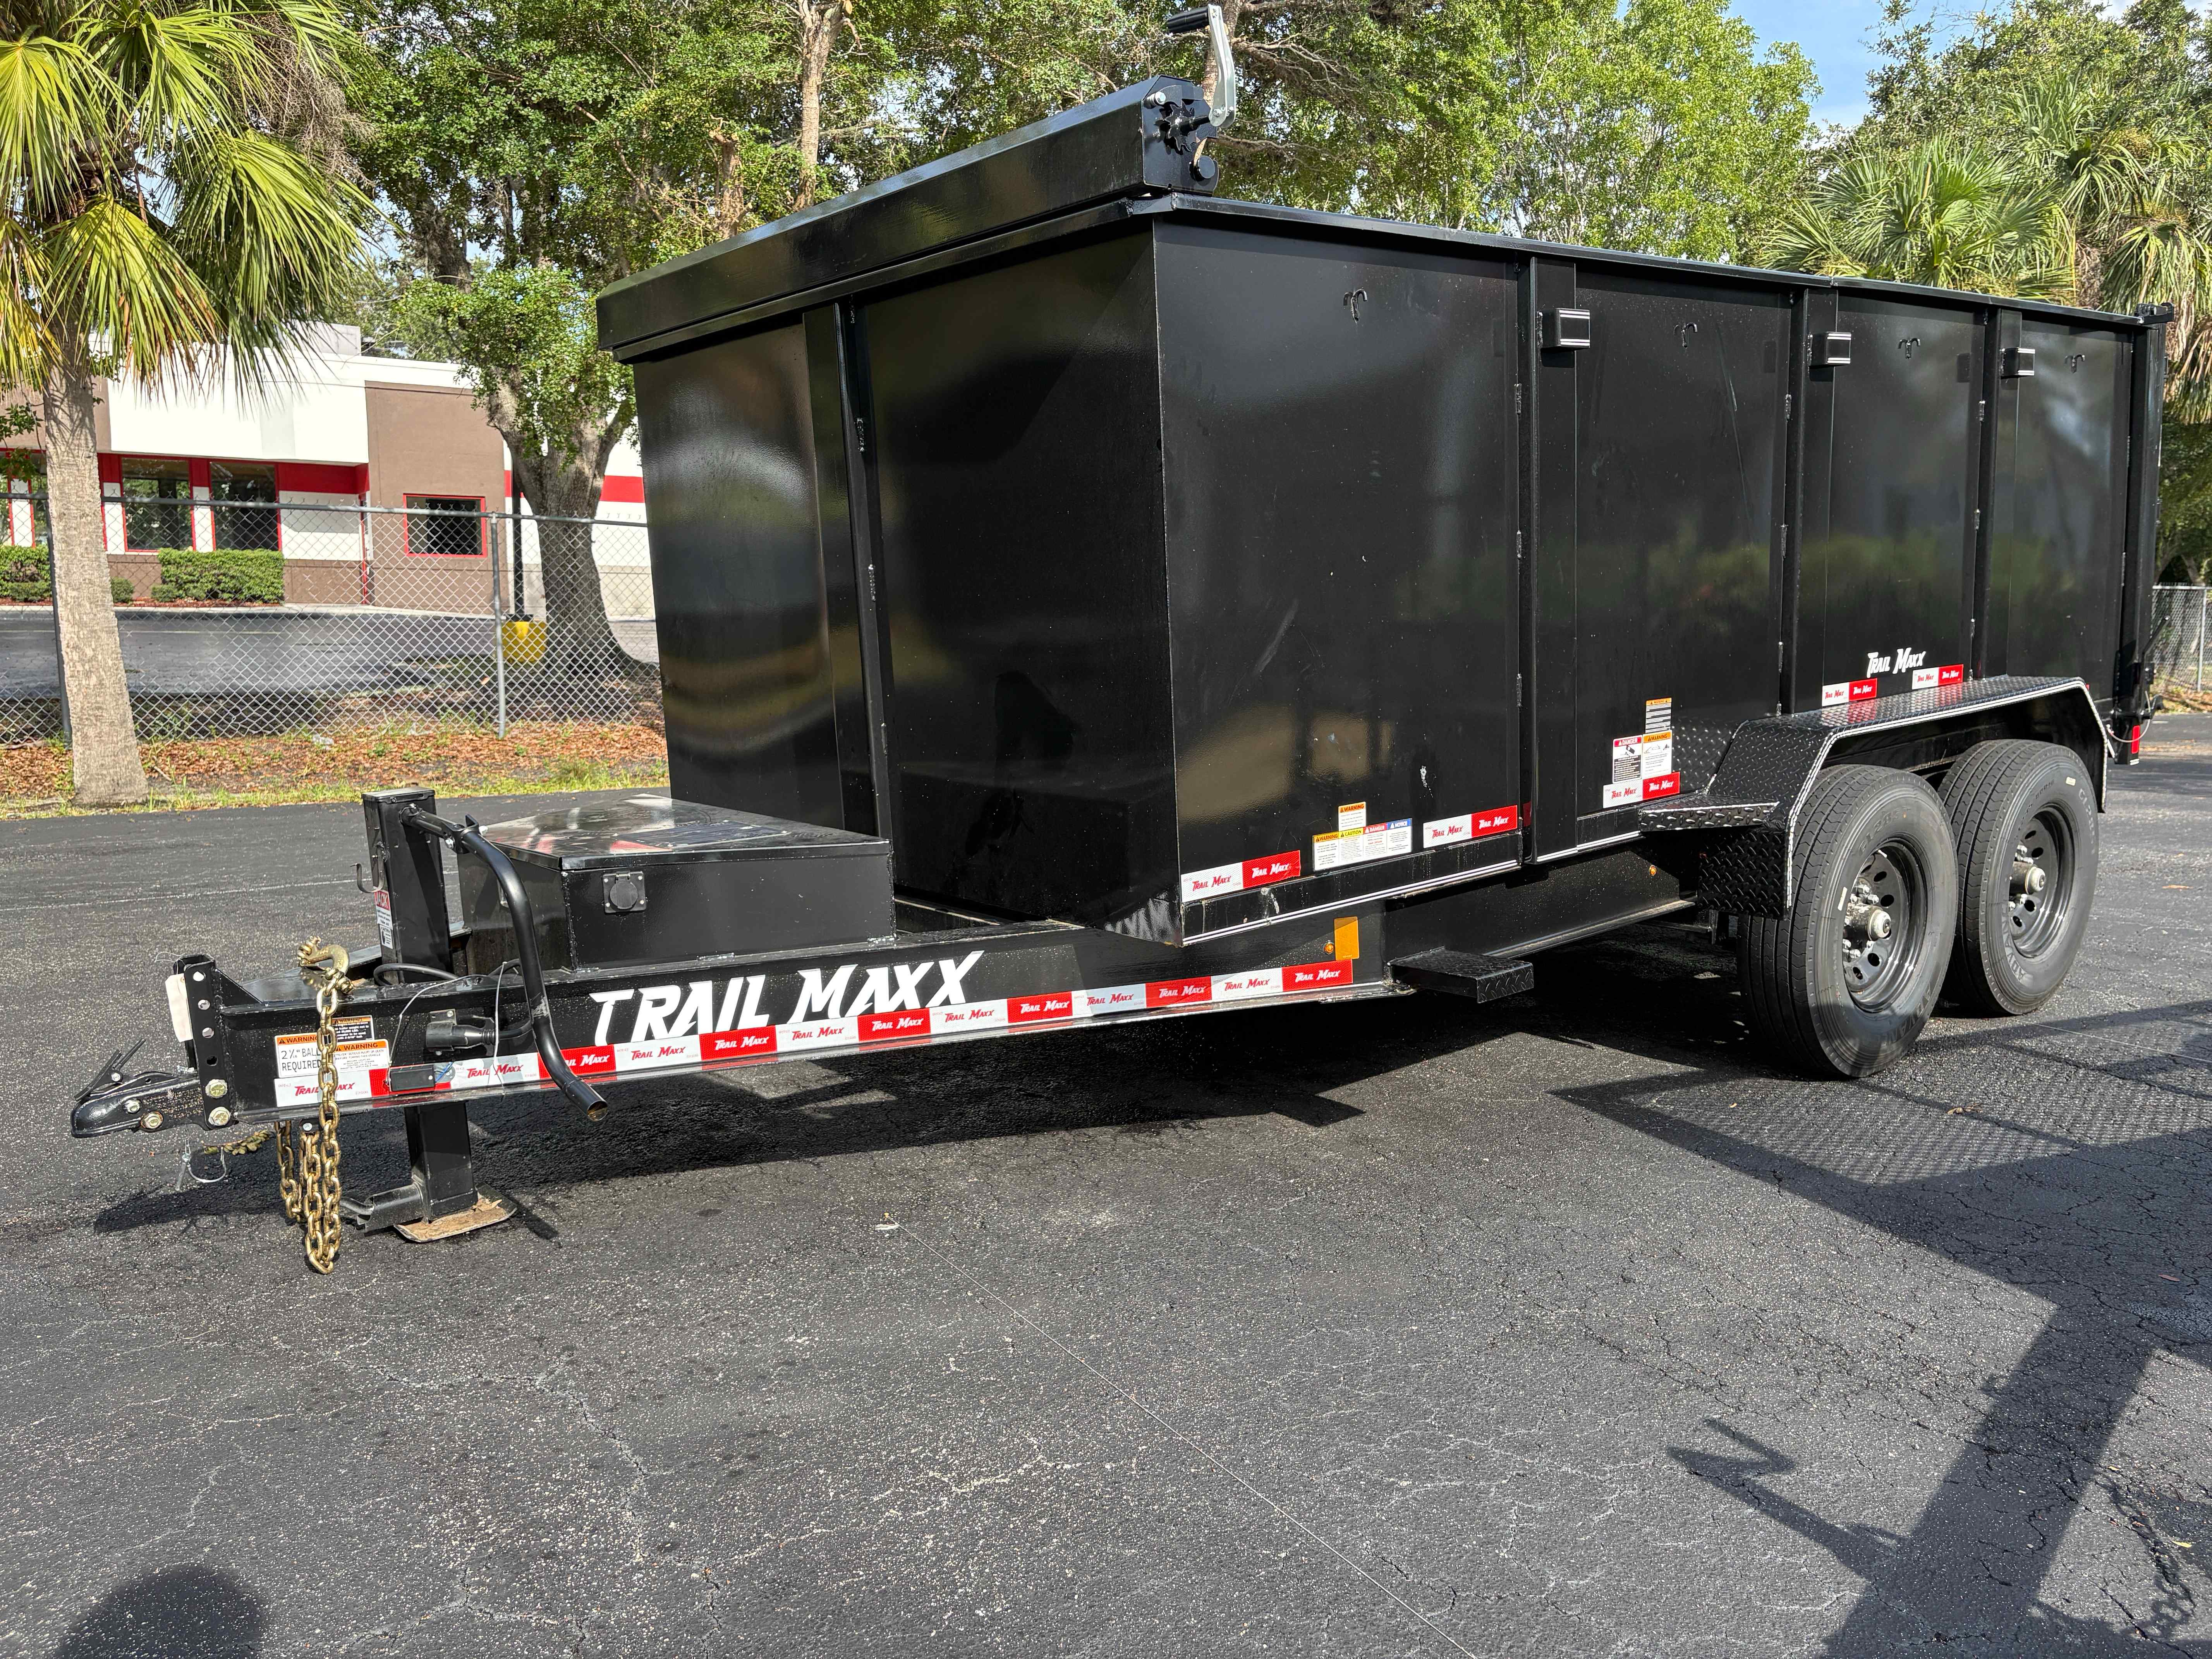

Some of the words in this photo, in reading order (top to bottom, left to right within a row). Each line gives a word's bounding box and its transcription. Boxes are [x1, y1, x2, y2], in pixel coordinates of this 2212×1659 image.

[1867, 652, 1891, 678] TRAIL
[1893, 647, 1926, 674] MAXX
[1344, 804, 1364, 812] WARNING
[1479, 819, 1491, 830] TRAIL
[1492, 816, 1509, 827] MAXX
[1432, 829, 1444, 839] TRAIL
[1447, 826, 1463, 836] MAXX
[1252, 867, 1267, 879] TRAIL
[1270, 862, 1290, 875] MAXX
[1192, 880, 1208, 891] TRAIL
[1211, 875, 1232, 888] MAXX
[1295, 972, 1314, 983] TRAIL
[1316, 969, 1341, 981] MAXX
[1159, 988, 1178, 998] TRAIL
[1181, 985, 1206, 996] MAXX
[1224, 982, 1242, 991] TRAIL
[1246, 978, 1270, 989] MAXX
[590, 974, 771, 1047] TRAIL
[787, 950, 985, 1025] MAXX
[1087, 996, 1105, 1006] TRAIL
[1109, 993, 1134, 1004] MAXX
[1020, 1003, 1040, 1014] TRAIL
[1043, 1000, 1070, 1012] MAXX
[945, 1012, 965, 1023] TRAIL
[969, 1008, 994, 1020] MAXX
[872, 1019, 893, 1032] TRAIL
[896, 1017, 924, 1029] MAXX
[792, 1030, 813, 1041] TRAIL
[816, 1026, 845, 1038] MAXX
[344, 1042, 378, 1051] WARNING
[714, 1039, 737, 1050] TRAIL
[740, 1035, 769, 1048] MAXX
[281, 1051, 288, 1059] 2
[302, 1048, 321, 1057] BALL
[579, 1054, 610, 1066] MAXX
[631, 1050, 653, 1060] TRAIL
[657, 1046, 686, 1058] MAXX
[282, 1059, 322, 1072] REQUIRED
[467, 1068, 490, 1079] TRAIL
[495, 1064, 524, 1075] MAXX
[335, 1082, 356, 1091] AXX
